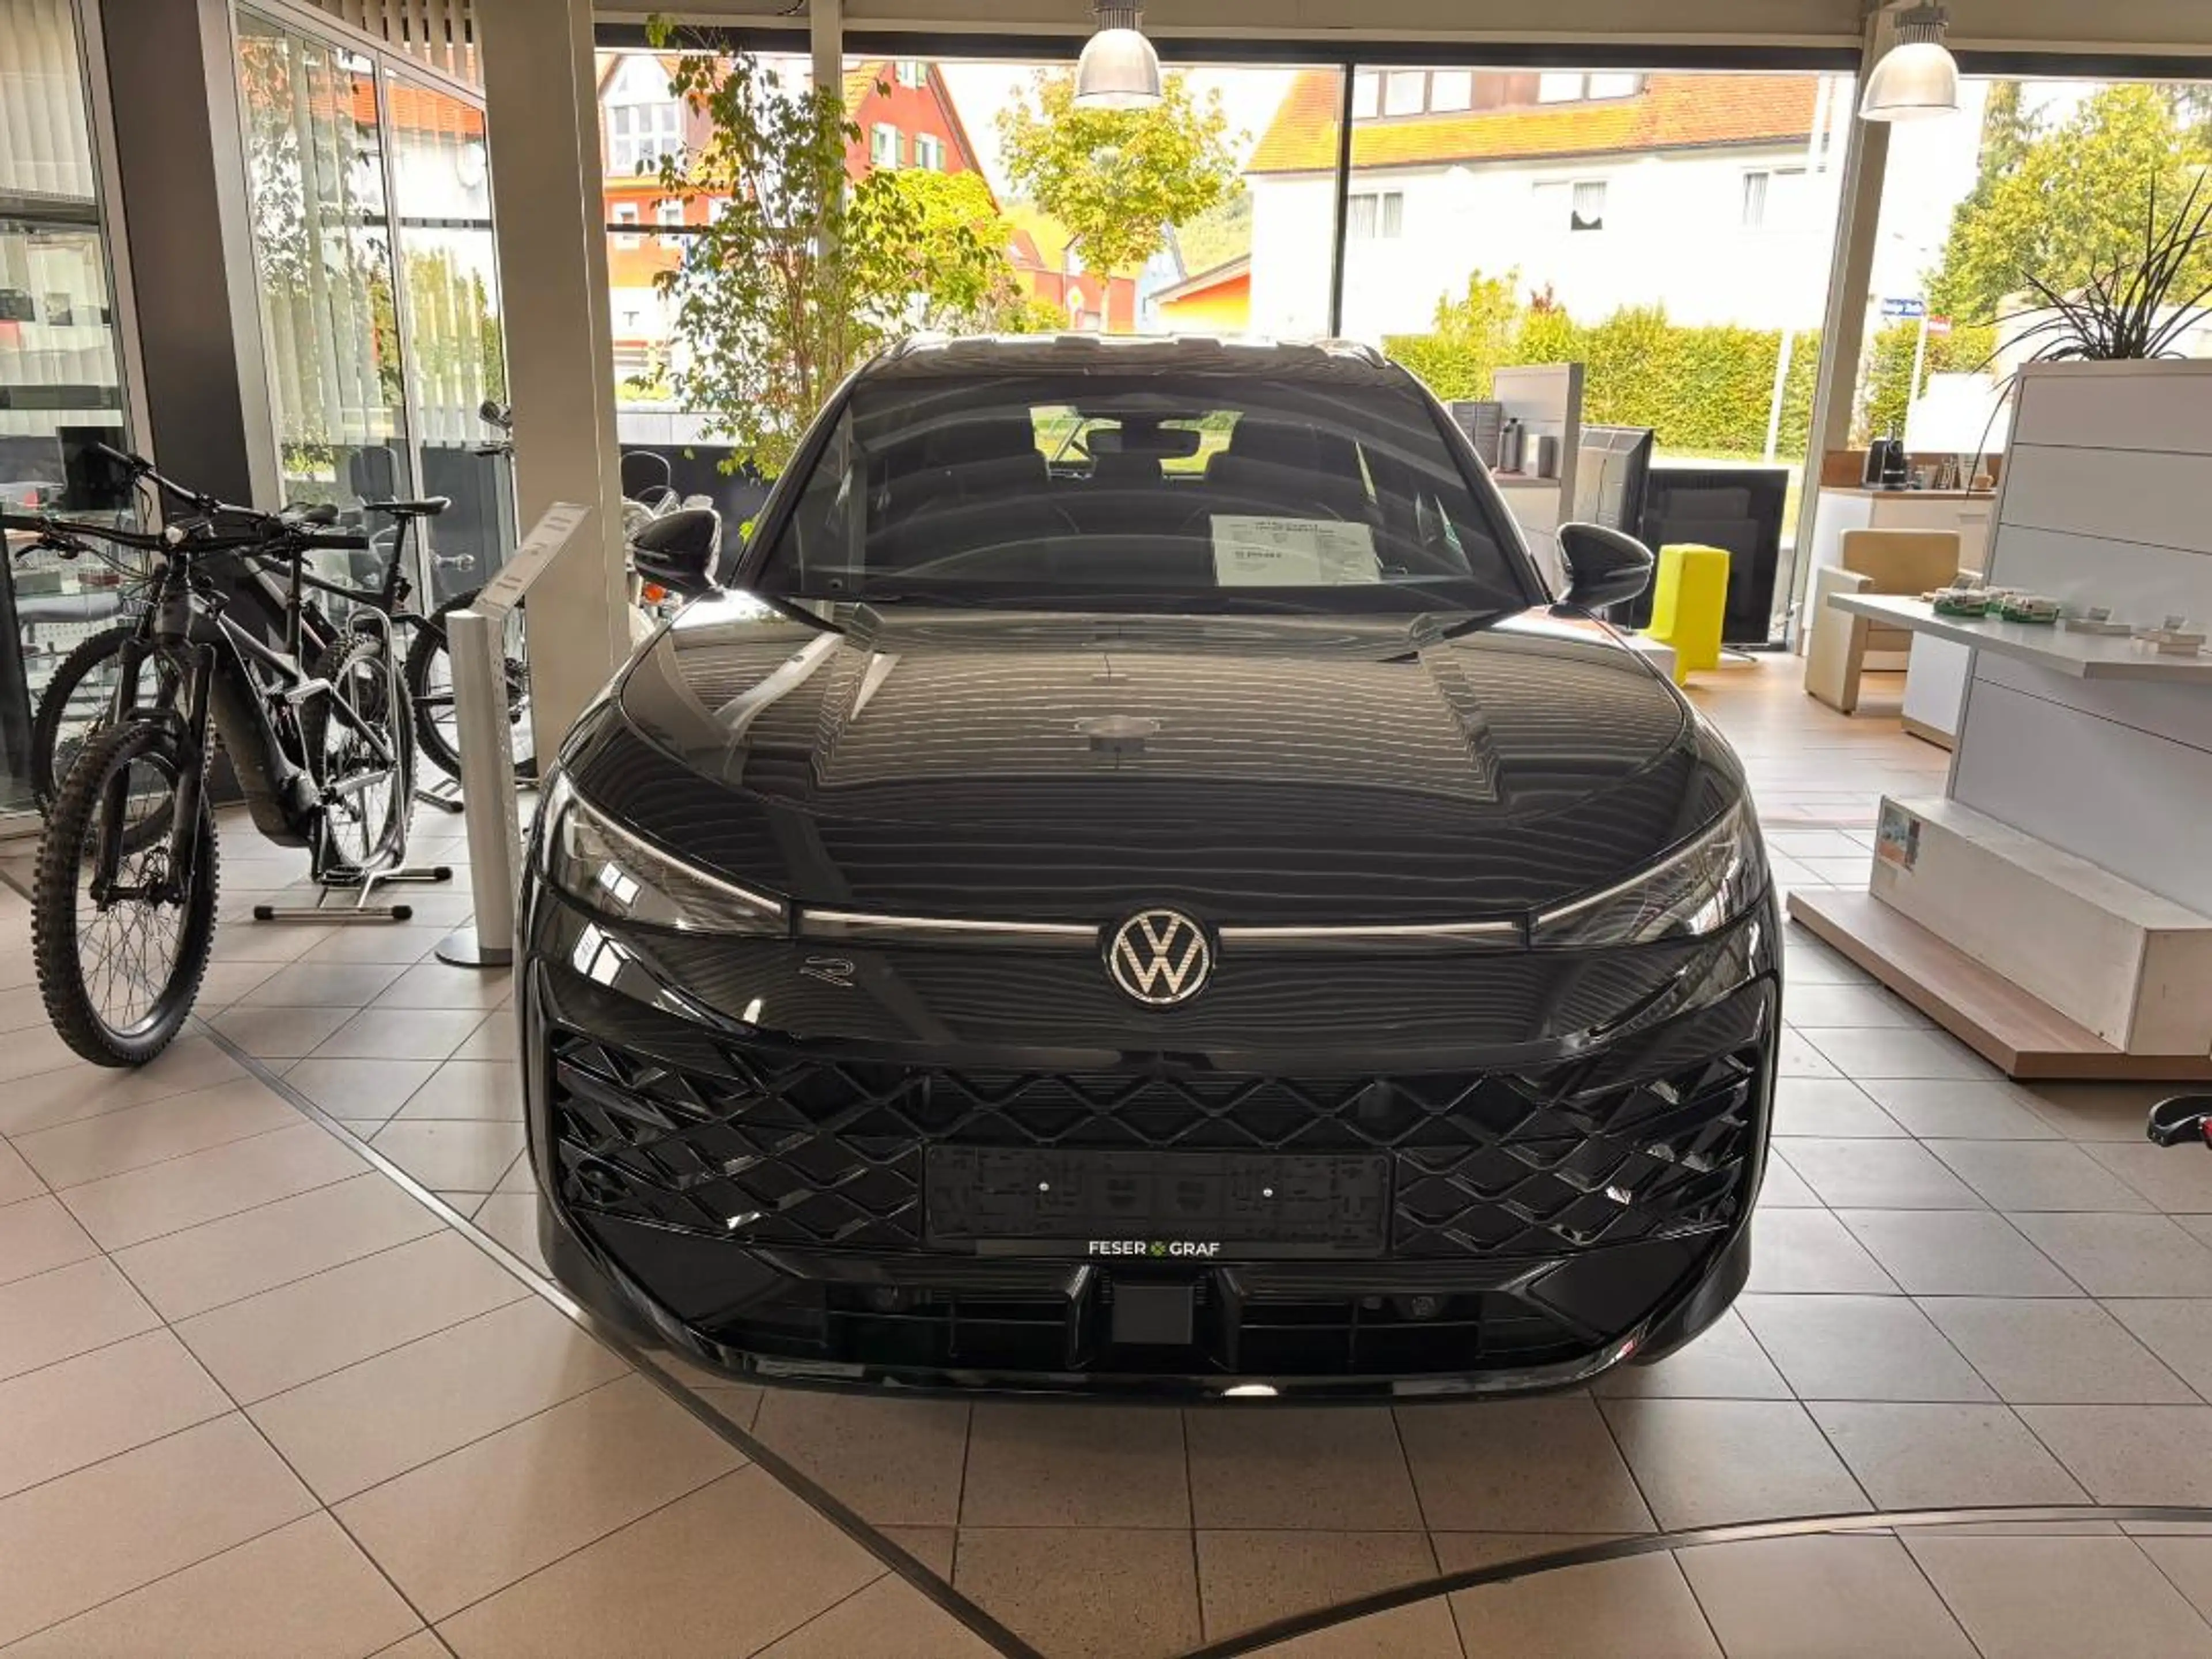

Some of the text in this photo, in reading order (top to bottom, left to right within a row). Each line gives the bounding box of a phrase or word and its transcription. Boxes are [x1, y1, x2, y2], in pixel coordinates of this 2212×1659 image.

[1116, 911, 1204, 997] VW
[1089, 1241, 1220, 1256] FESER GRAF
